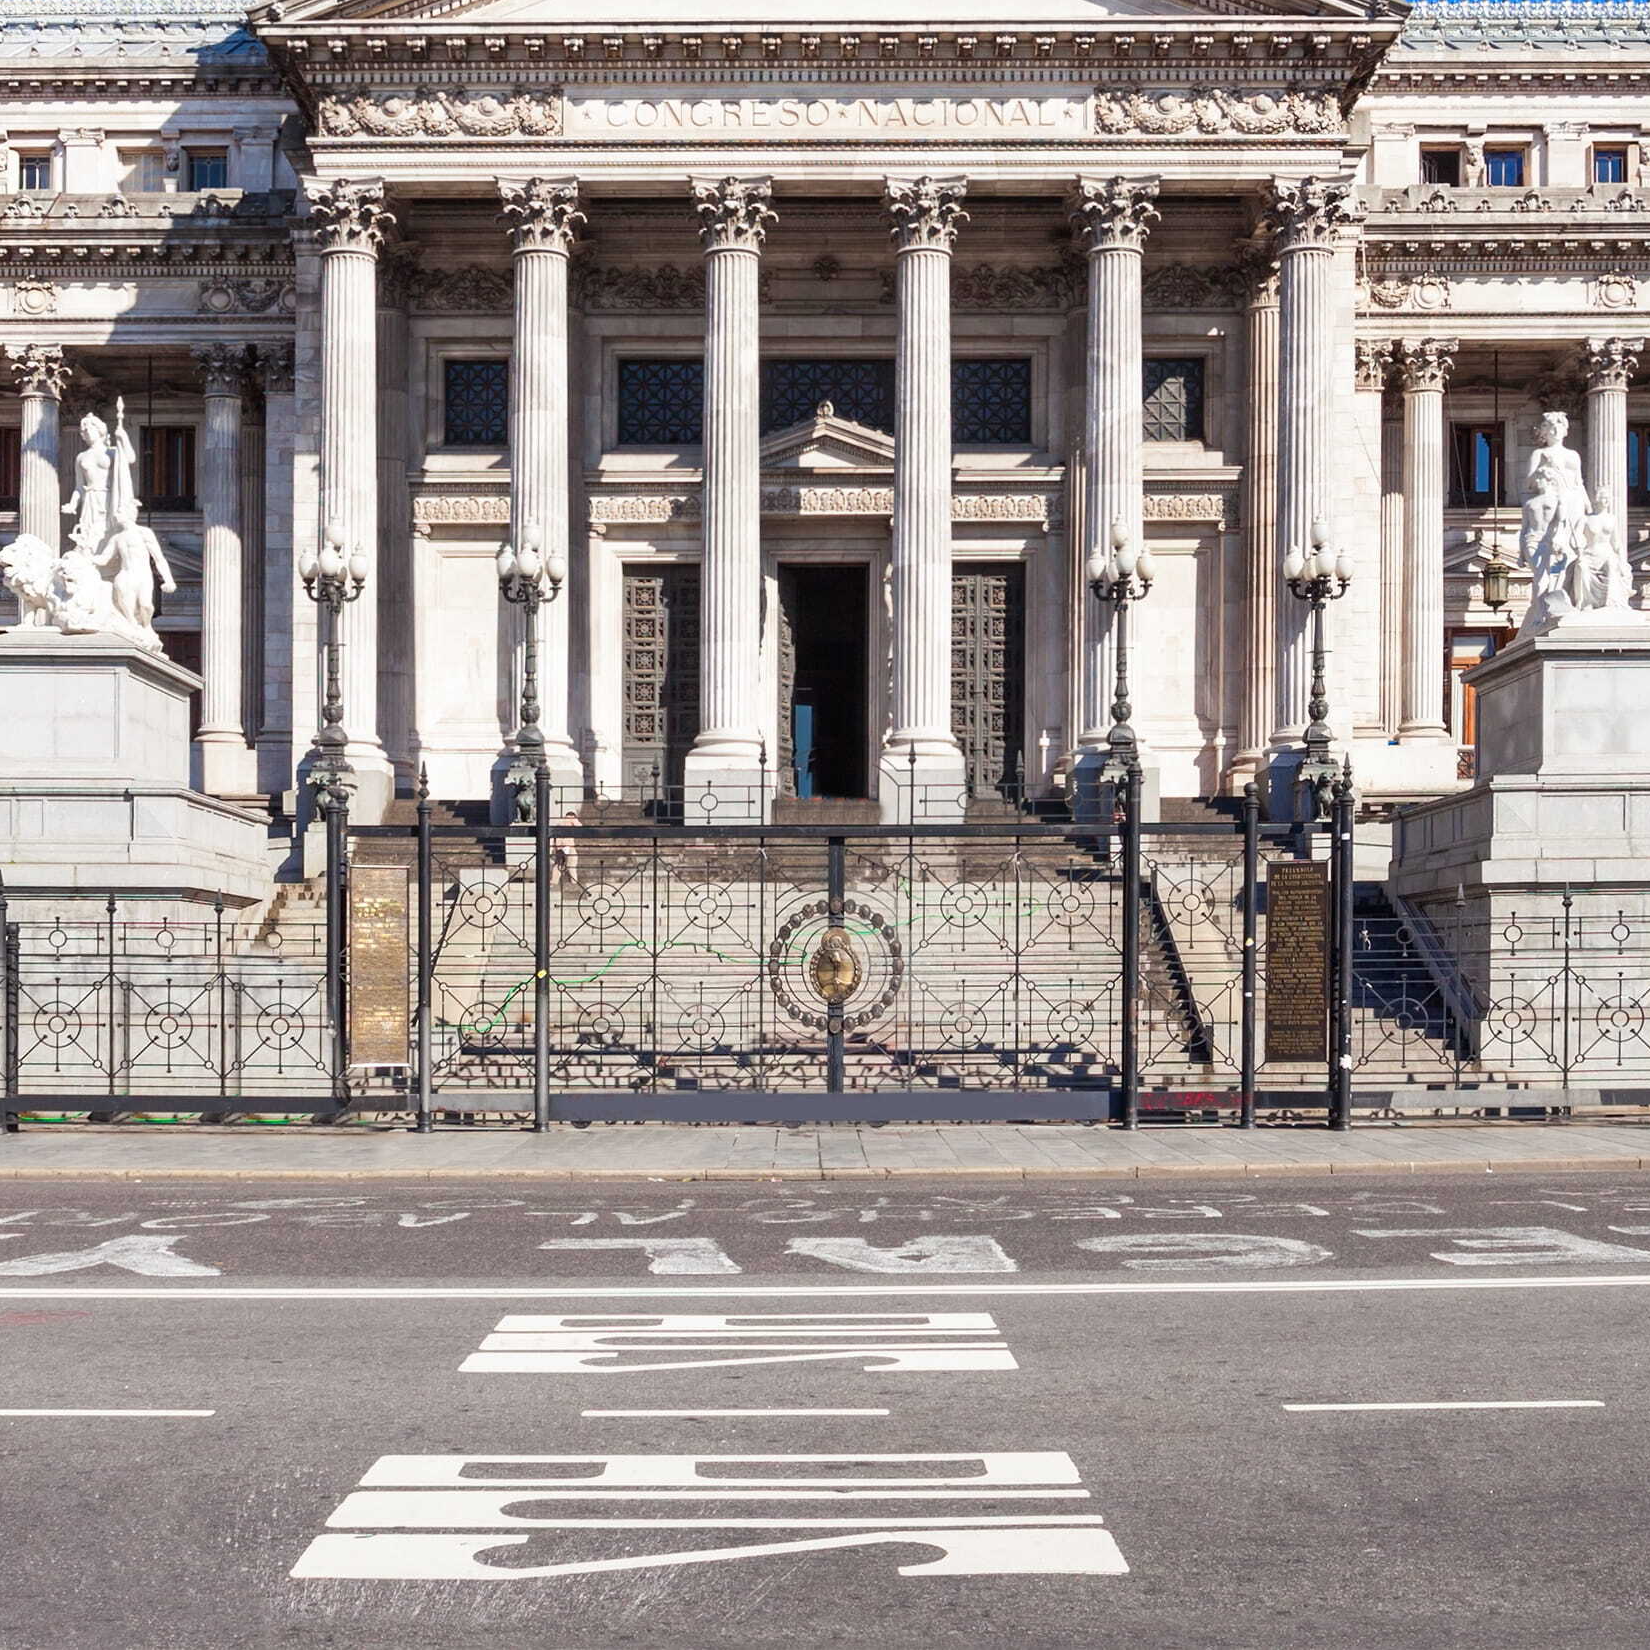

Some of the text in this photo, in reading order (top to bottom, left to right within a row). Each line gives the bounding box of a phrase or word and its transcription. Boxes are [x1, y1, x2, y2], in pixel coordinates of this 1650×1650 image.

[606, 100, 1055, 127] CONGRESO NACIONAL
[524, 1211, 688, 1225] AL
[749, 1201, 1446, 1223] DERECHO
[457, 1312, 1020, 1373] BUS
[288, 1451, 1131, 1580] BUS
